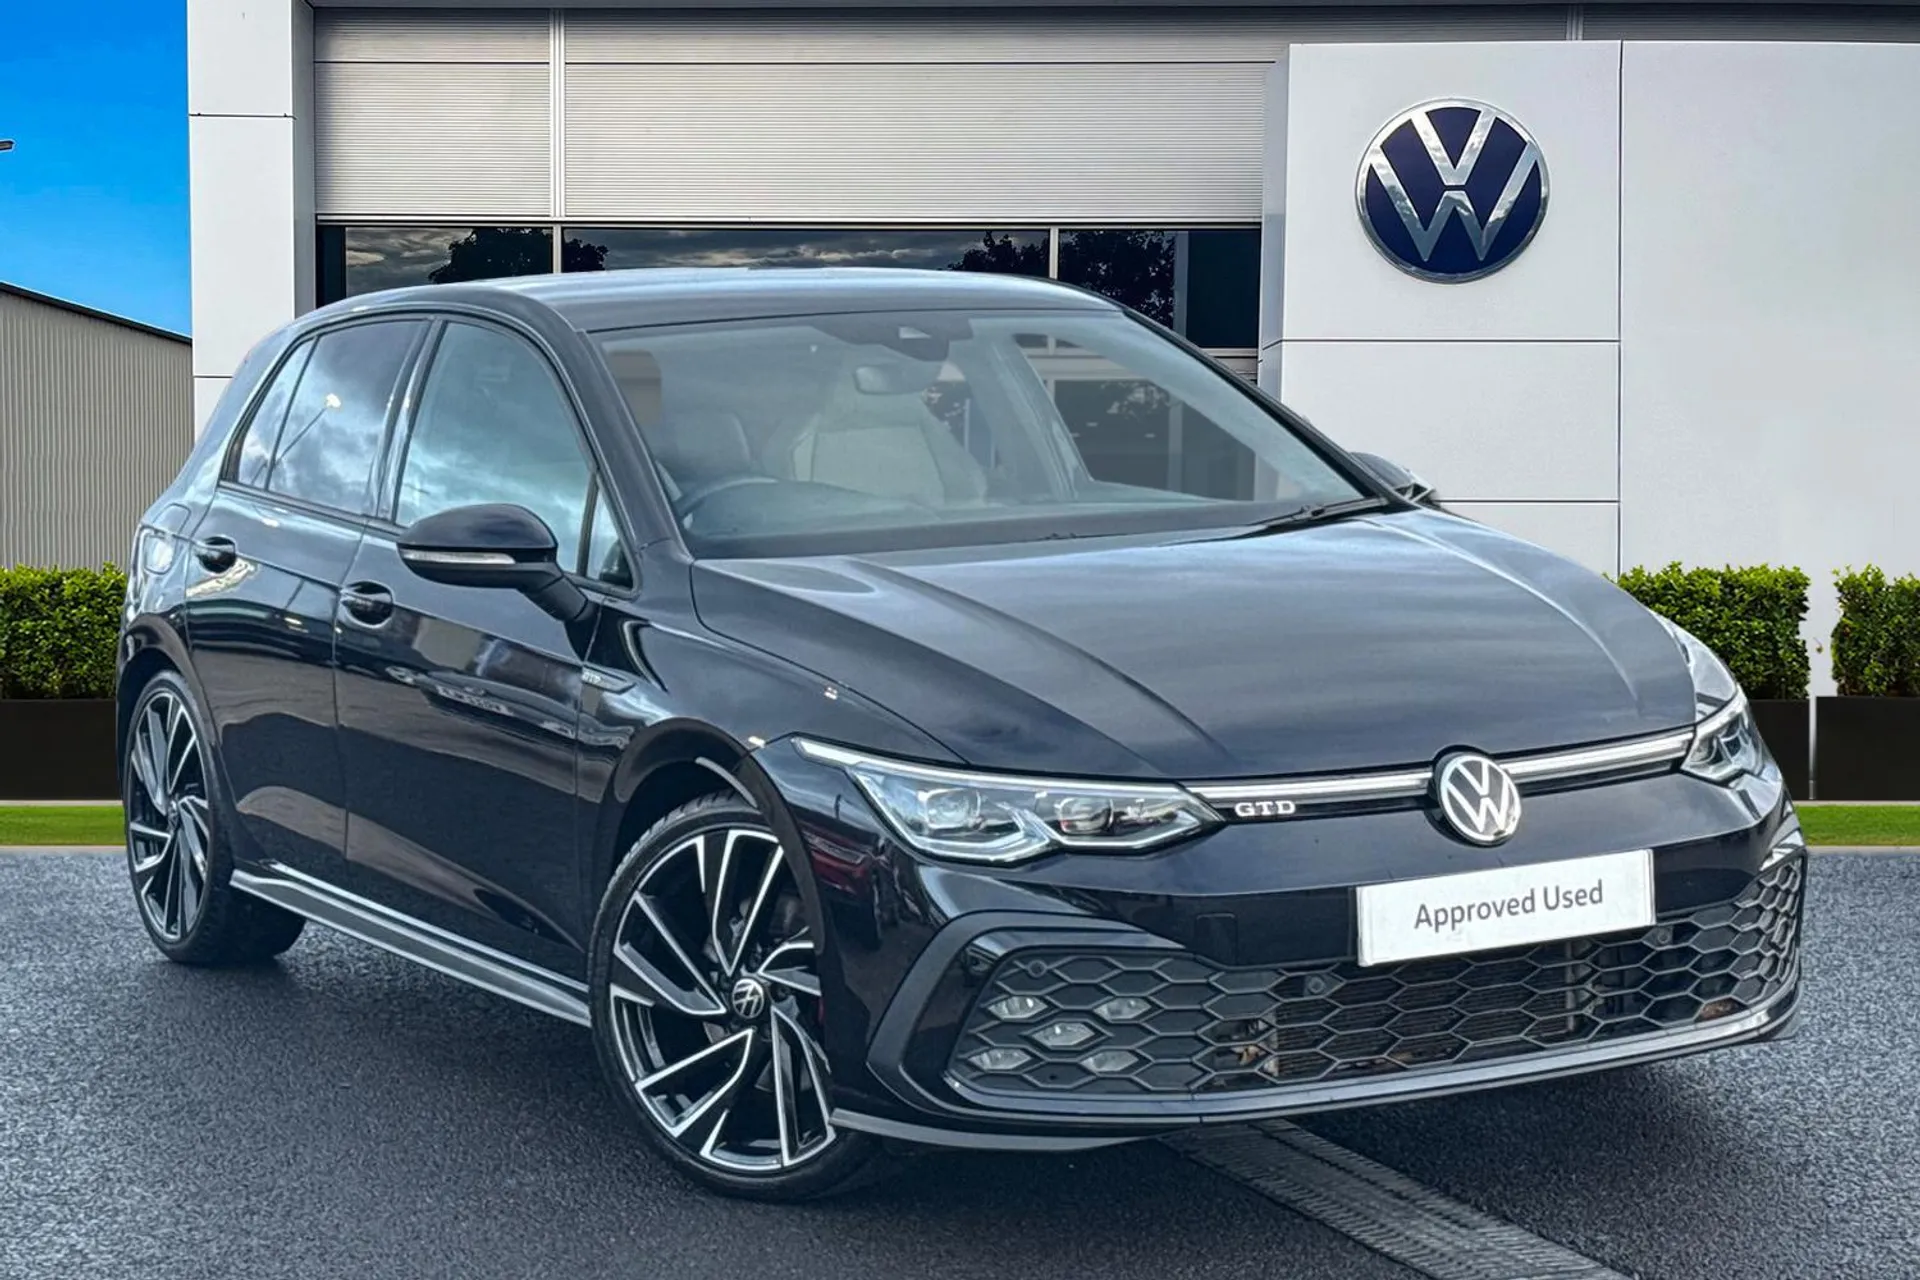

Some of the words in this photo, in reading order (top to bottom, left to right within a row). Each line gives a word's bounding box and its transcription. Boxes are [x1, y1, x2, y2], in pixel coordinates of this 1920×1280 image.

[1234, 800, 1296, 817] GTD
[1414, 887, 1536, 933] Approved
[1543, 878, 1603, 911] Used
